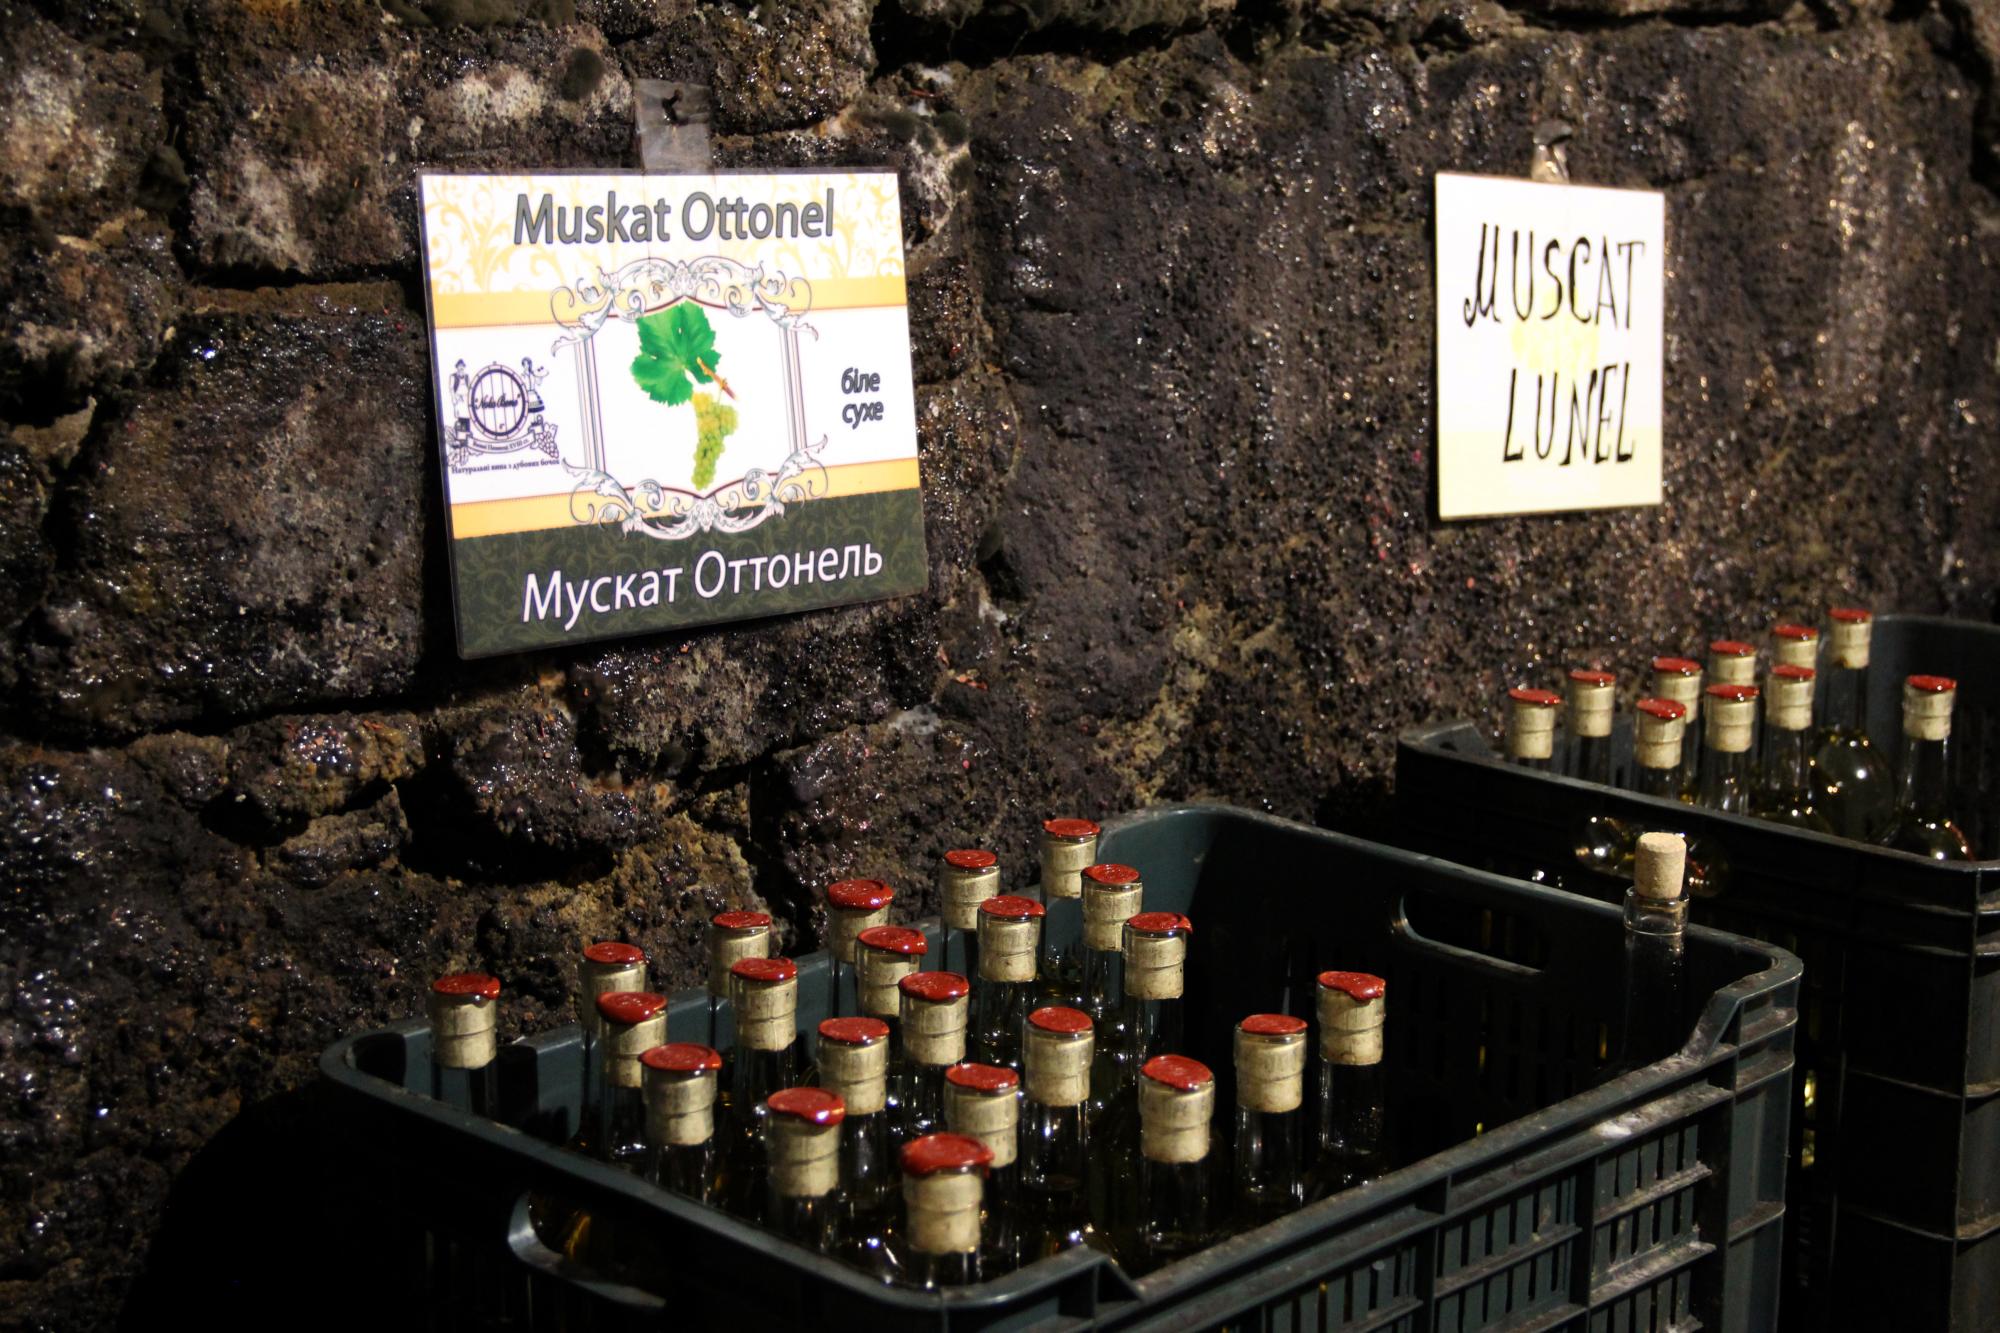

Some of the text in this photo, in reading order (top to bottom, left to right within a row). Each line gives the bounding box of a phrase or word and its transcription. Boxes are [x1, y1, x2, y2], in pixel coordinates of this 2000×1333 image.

[514, 187, 835, 245] Muskat Ottonel
[1463, 222, 1645, 330] MUSCAT
[841, 367, 881, 395] біле
[842, 401, 884, 430] сухе
[1503, 362, 1635, 467] LUNEL
[522, 542, 883, 632] Мускат Оттонель
